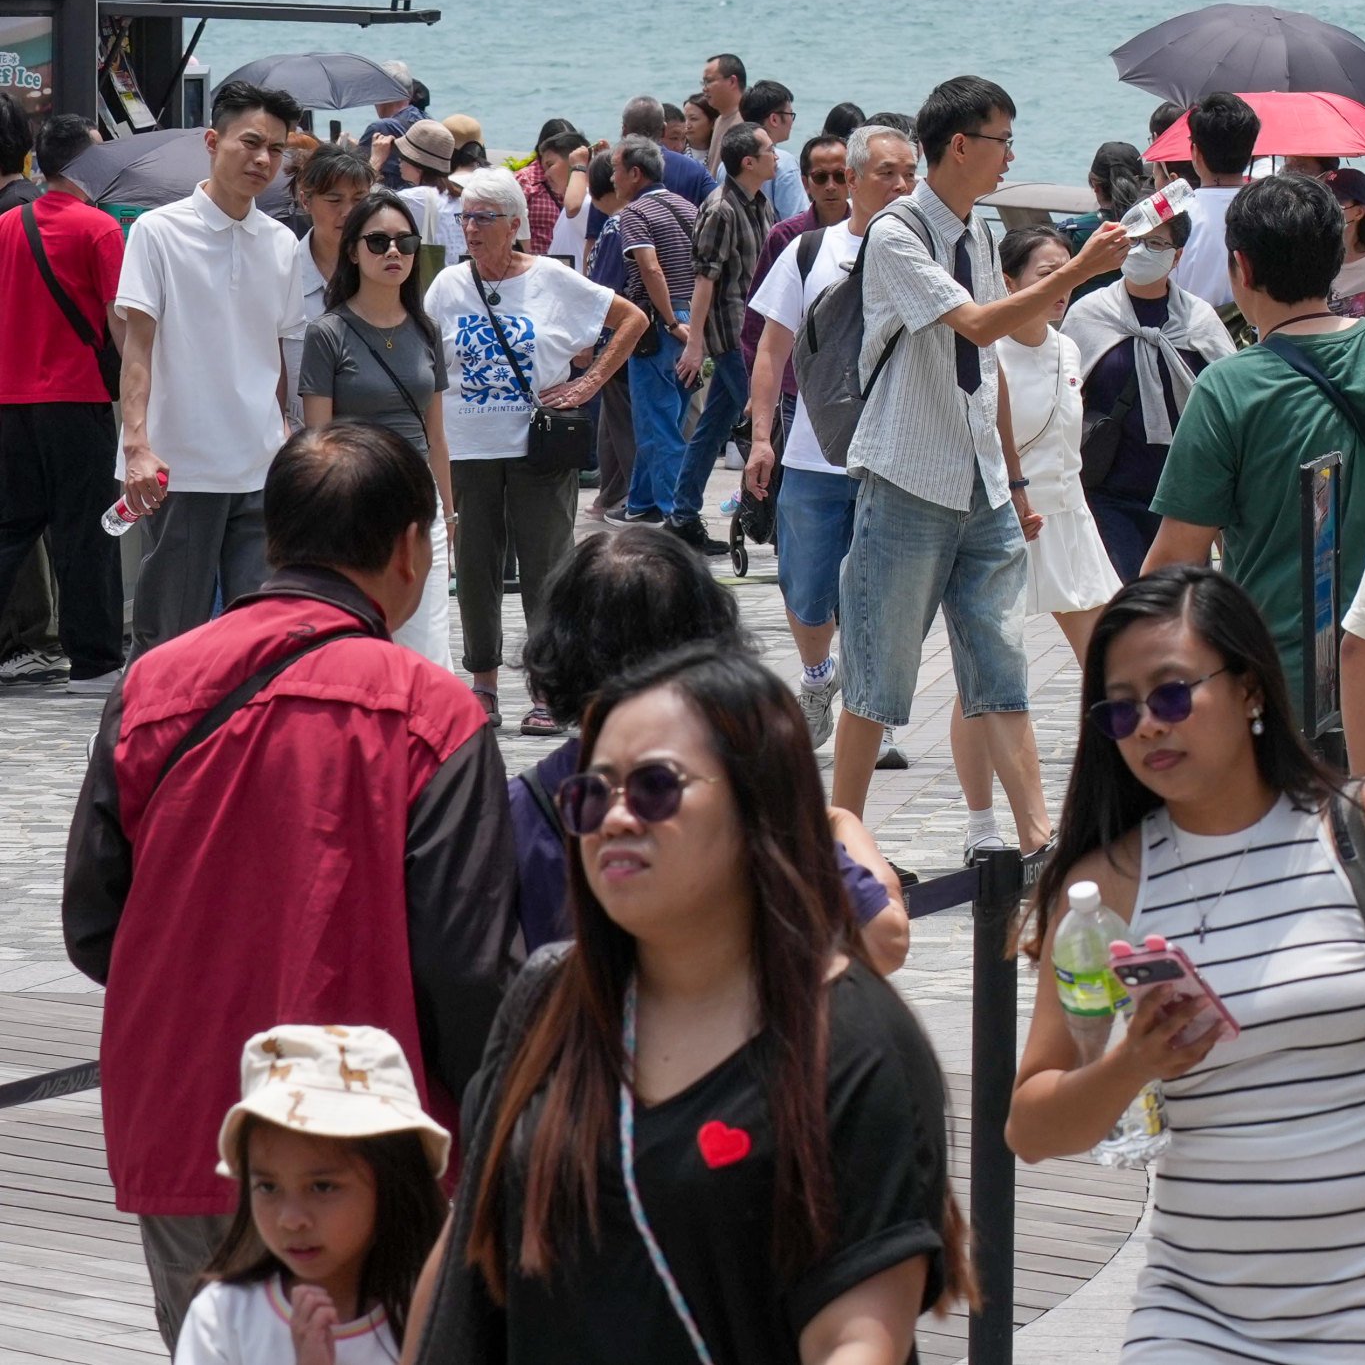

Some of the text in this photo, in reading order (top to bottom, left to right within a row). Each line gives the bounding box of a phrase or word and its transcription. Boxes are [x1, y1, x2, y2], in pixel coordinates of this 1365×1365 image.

[16, 68, 41, 87] Ice
[477, 406, 485, 414] LE
[487, 404, 532, 413] PRINTEMPS
[22, 1067, 100, 1103] AVENUE
